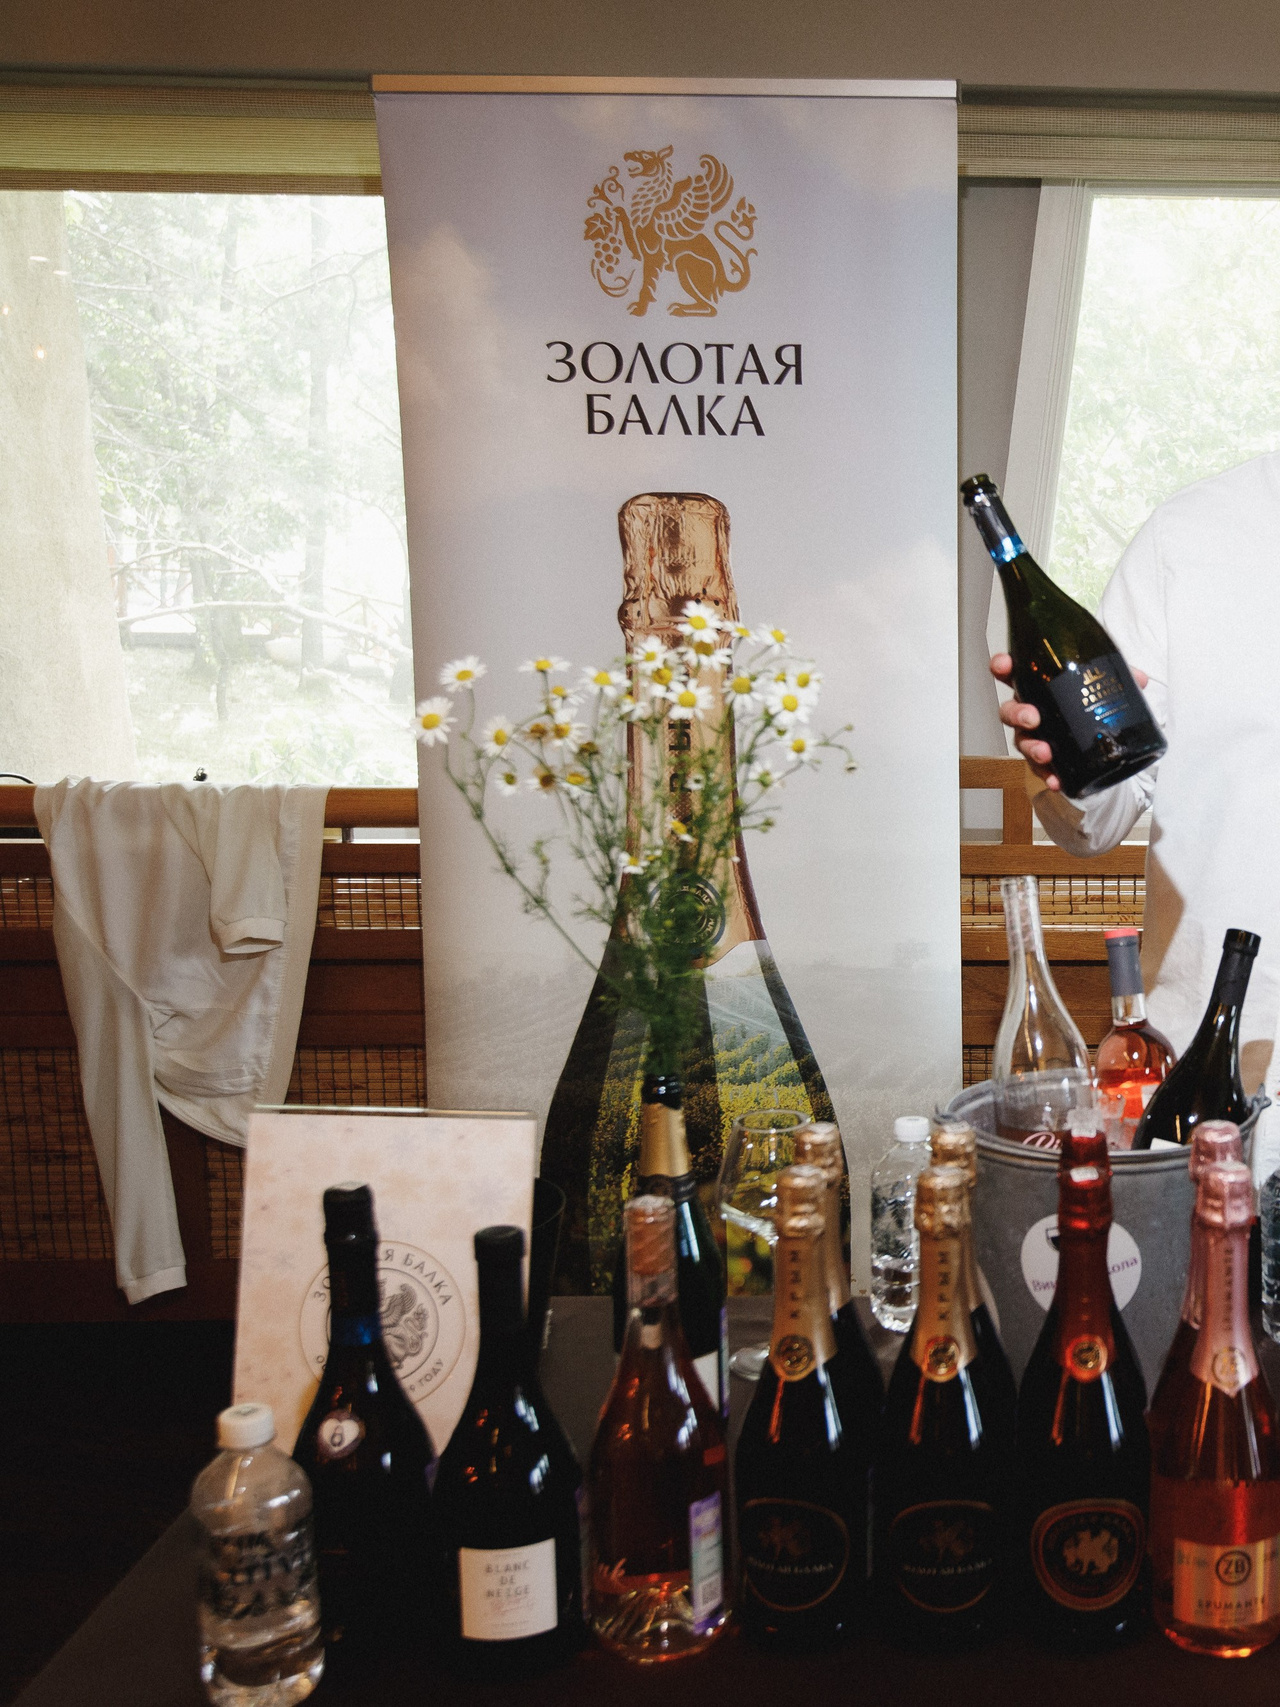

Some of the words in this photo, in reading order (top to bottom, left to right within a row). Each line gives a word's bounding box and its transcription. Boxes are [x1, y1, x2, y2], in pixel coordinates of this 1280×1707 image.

[545, 340, 803, 386] ЗОЛОТАЯ
[585, 393, 766, 437] БАЛКА
[403, 1252, 453, 1306] БАЛКА
[485, 1560, 529, 1573] BLANC
[500, 1575, 515, 1585] DE
[1222, 1558, 1246, 1576] ZB
